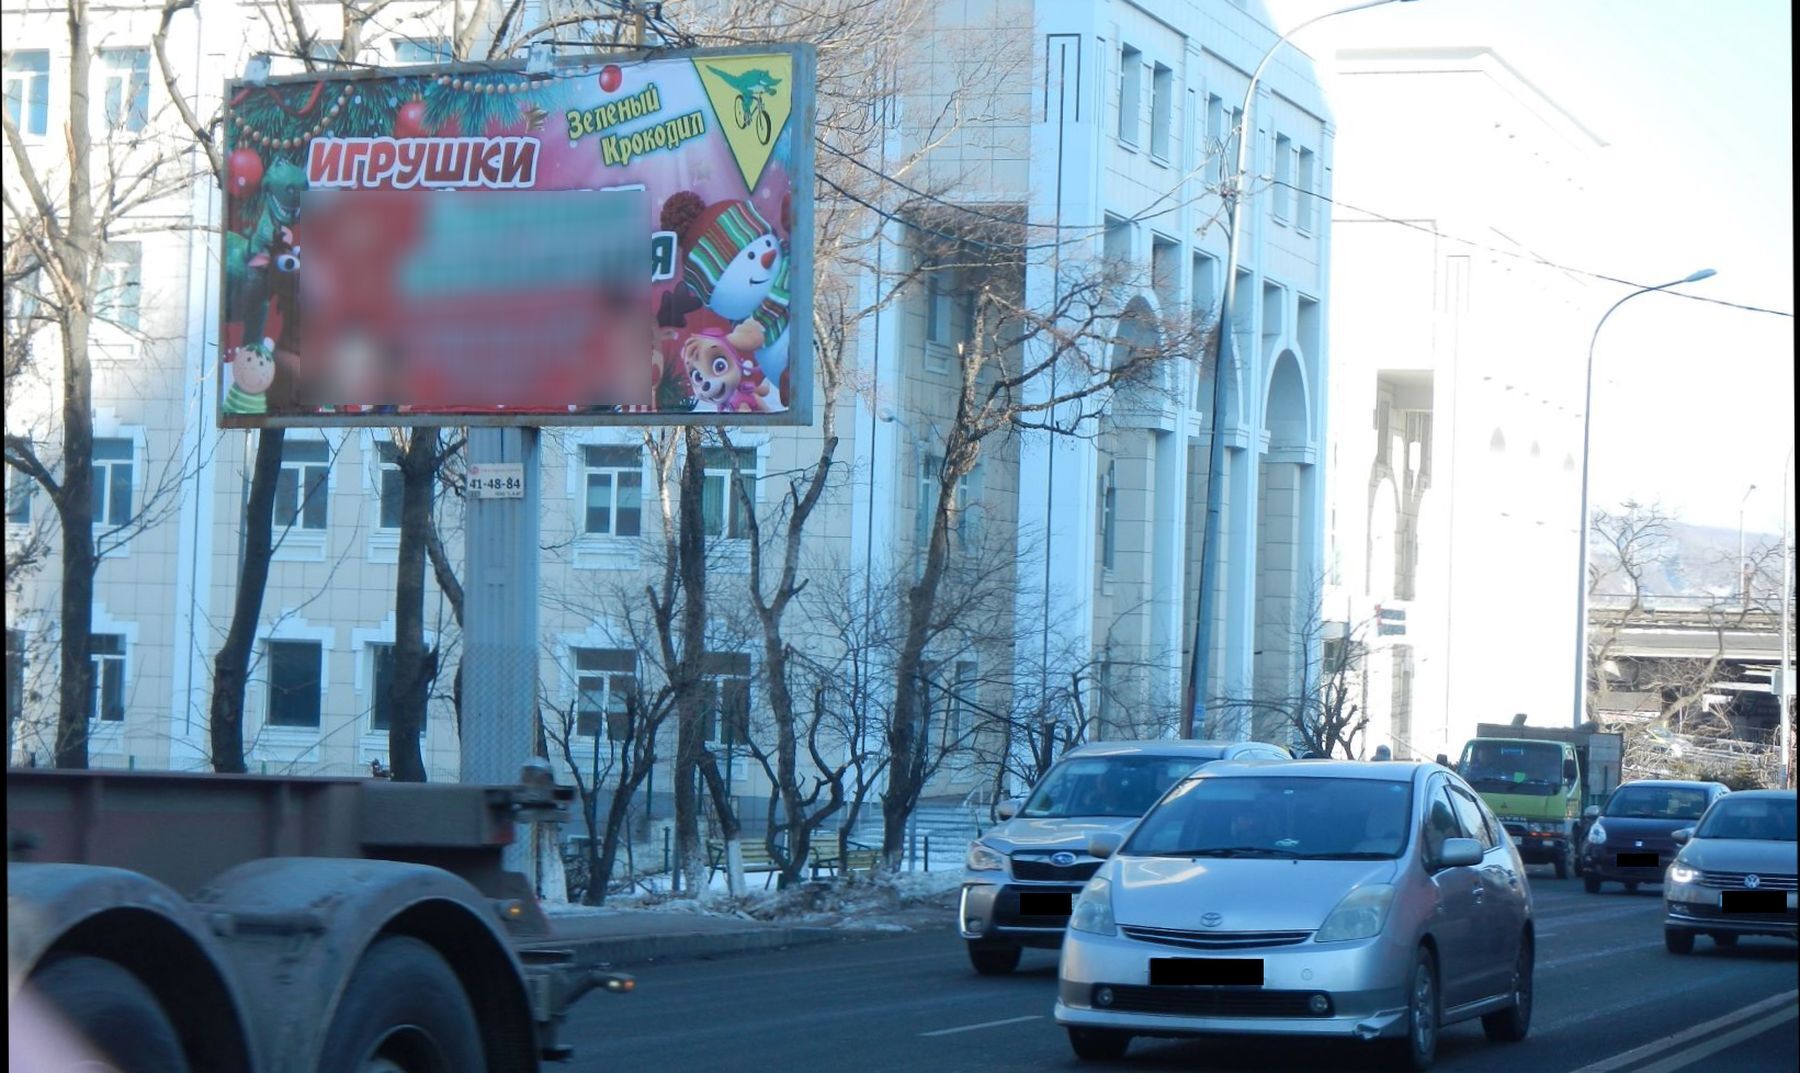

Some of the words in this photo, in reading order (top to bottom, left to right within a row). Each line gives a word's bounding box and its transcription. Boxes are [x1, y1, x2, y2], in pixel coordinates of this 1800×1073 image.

[567, 83, 661, 139] Зеленый
[309, 138, 539, 187] ИГРУШКИ
[600, 110, 705, 166] Крокодил
[469, 477, 521, 490] 41-48-84
